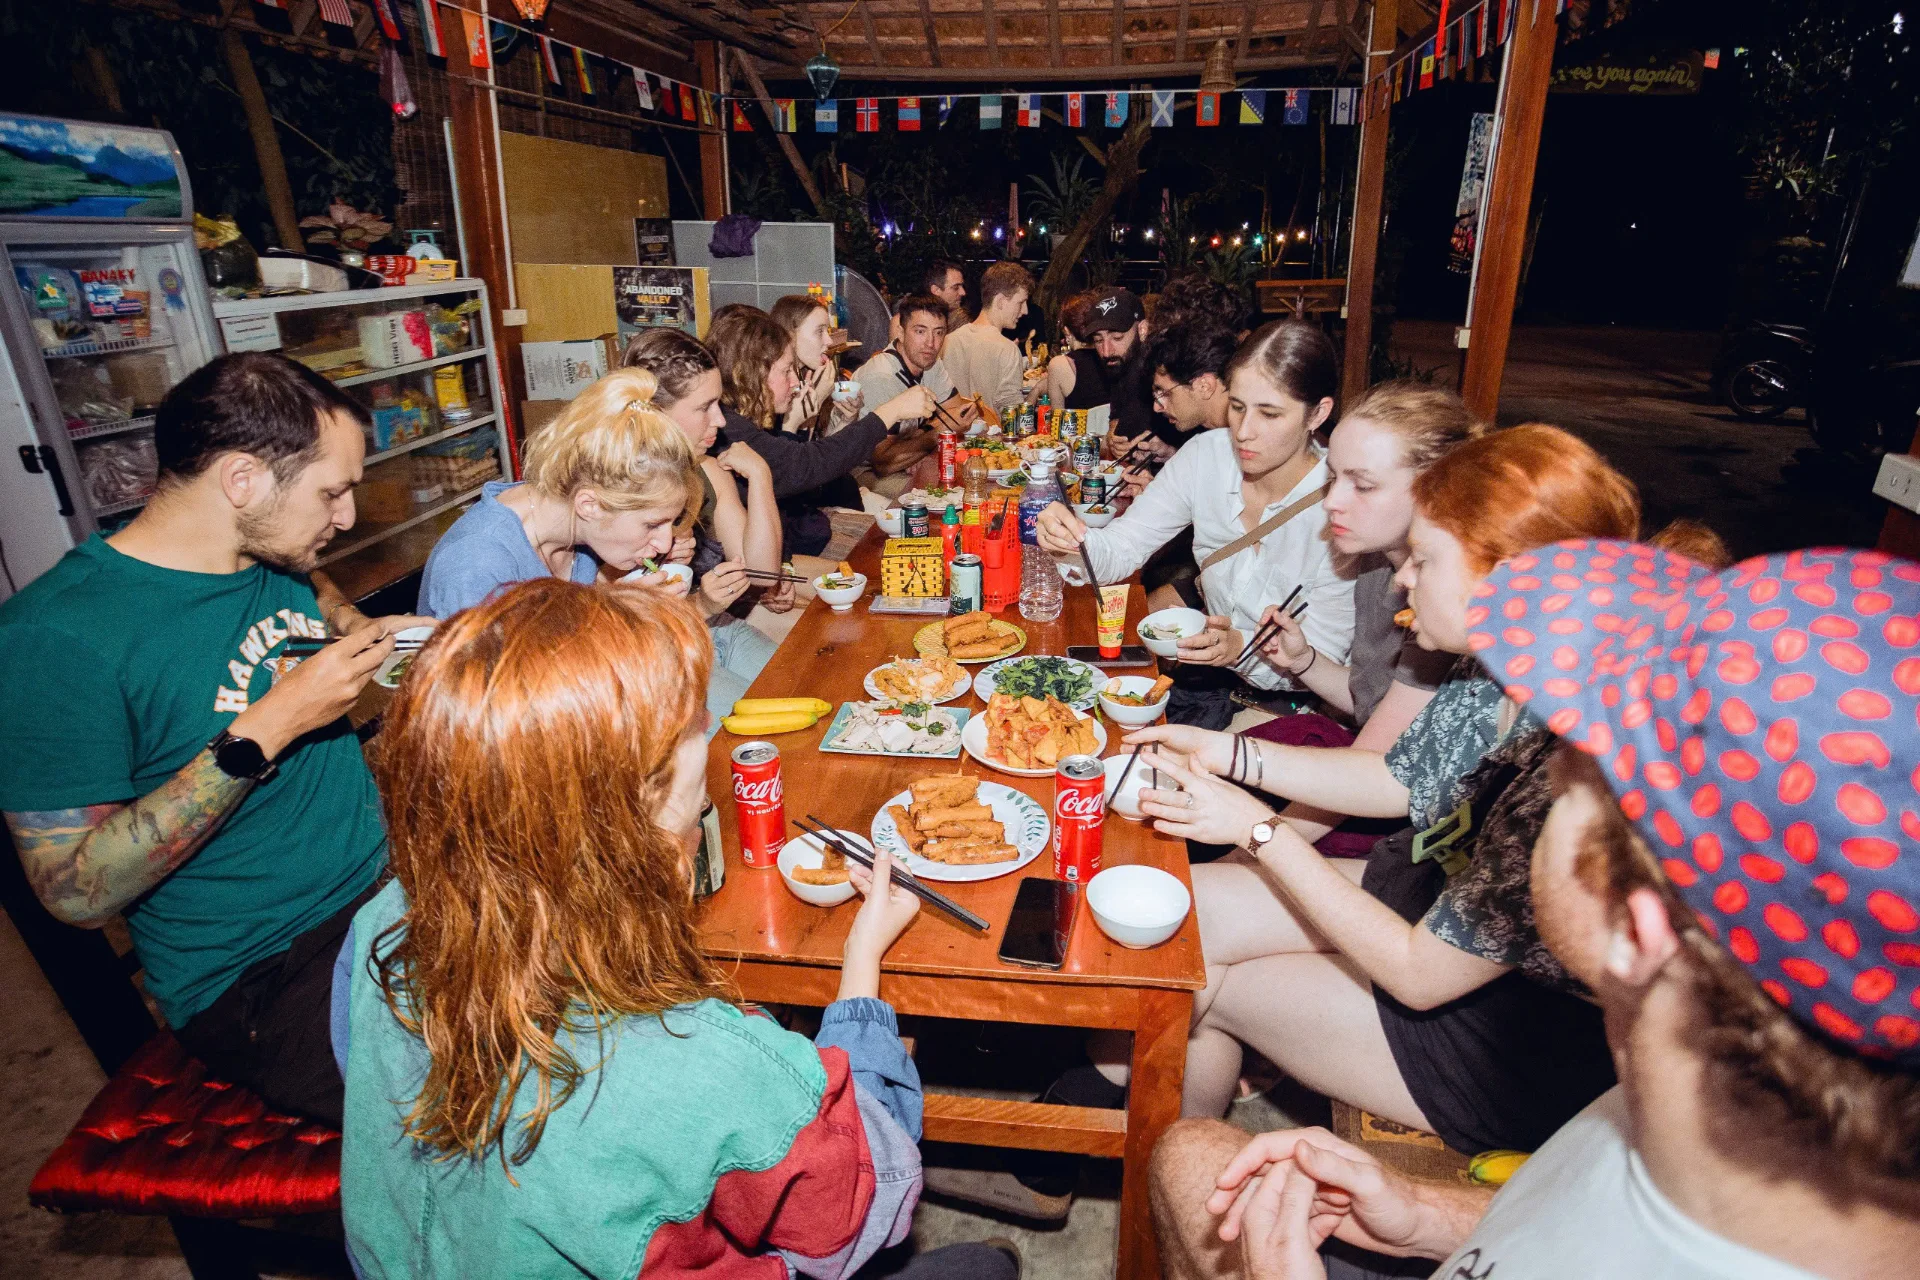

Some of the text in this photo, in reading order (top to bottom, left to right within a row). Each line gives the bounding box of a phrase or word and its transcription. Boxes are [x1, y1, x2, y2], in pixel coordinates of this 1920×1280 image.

[1584, 66, 1631, 91] you
[1628, 62, 1692, 92] again
[625, 285, 684, 296] ABANDONED
[637, 295, 672, 304] VALLEY
[213, 608, 326, 714] HAWKINS
